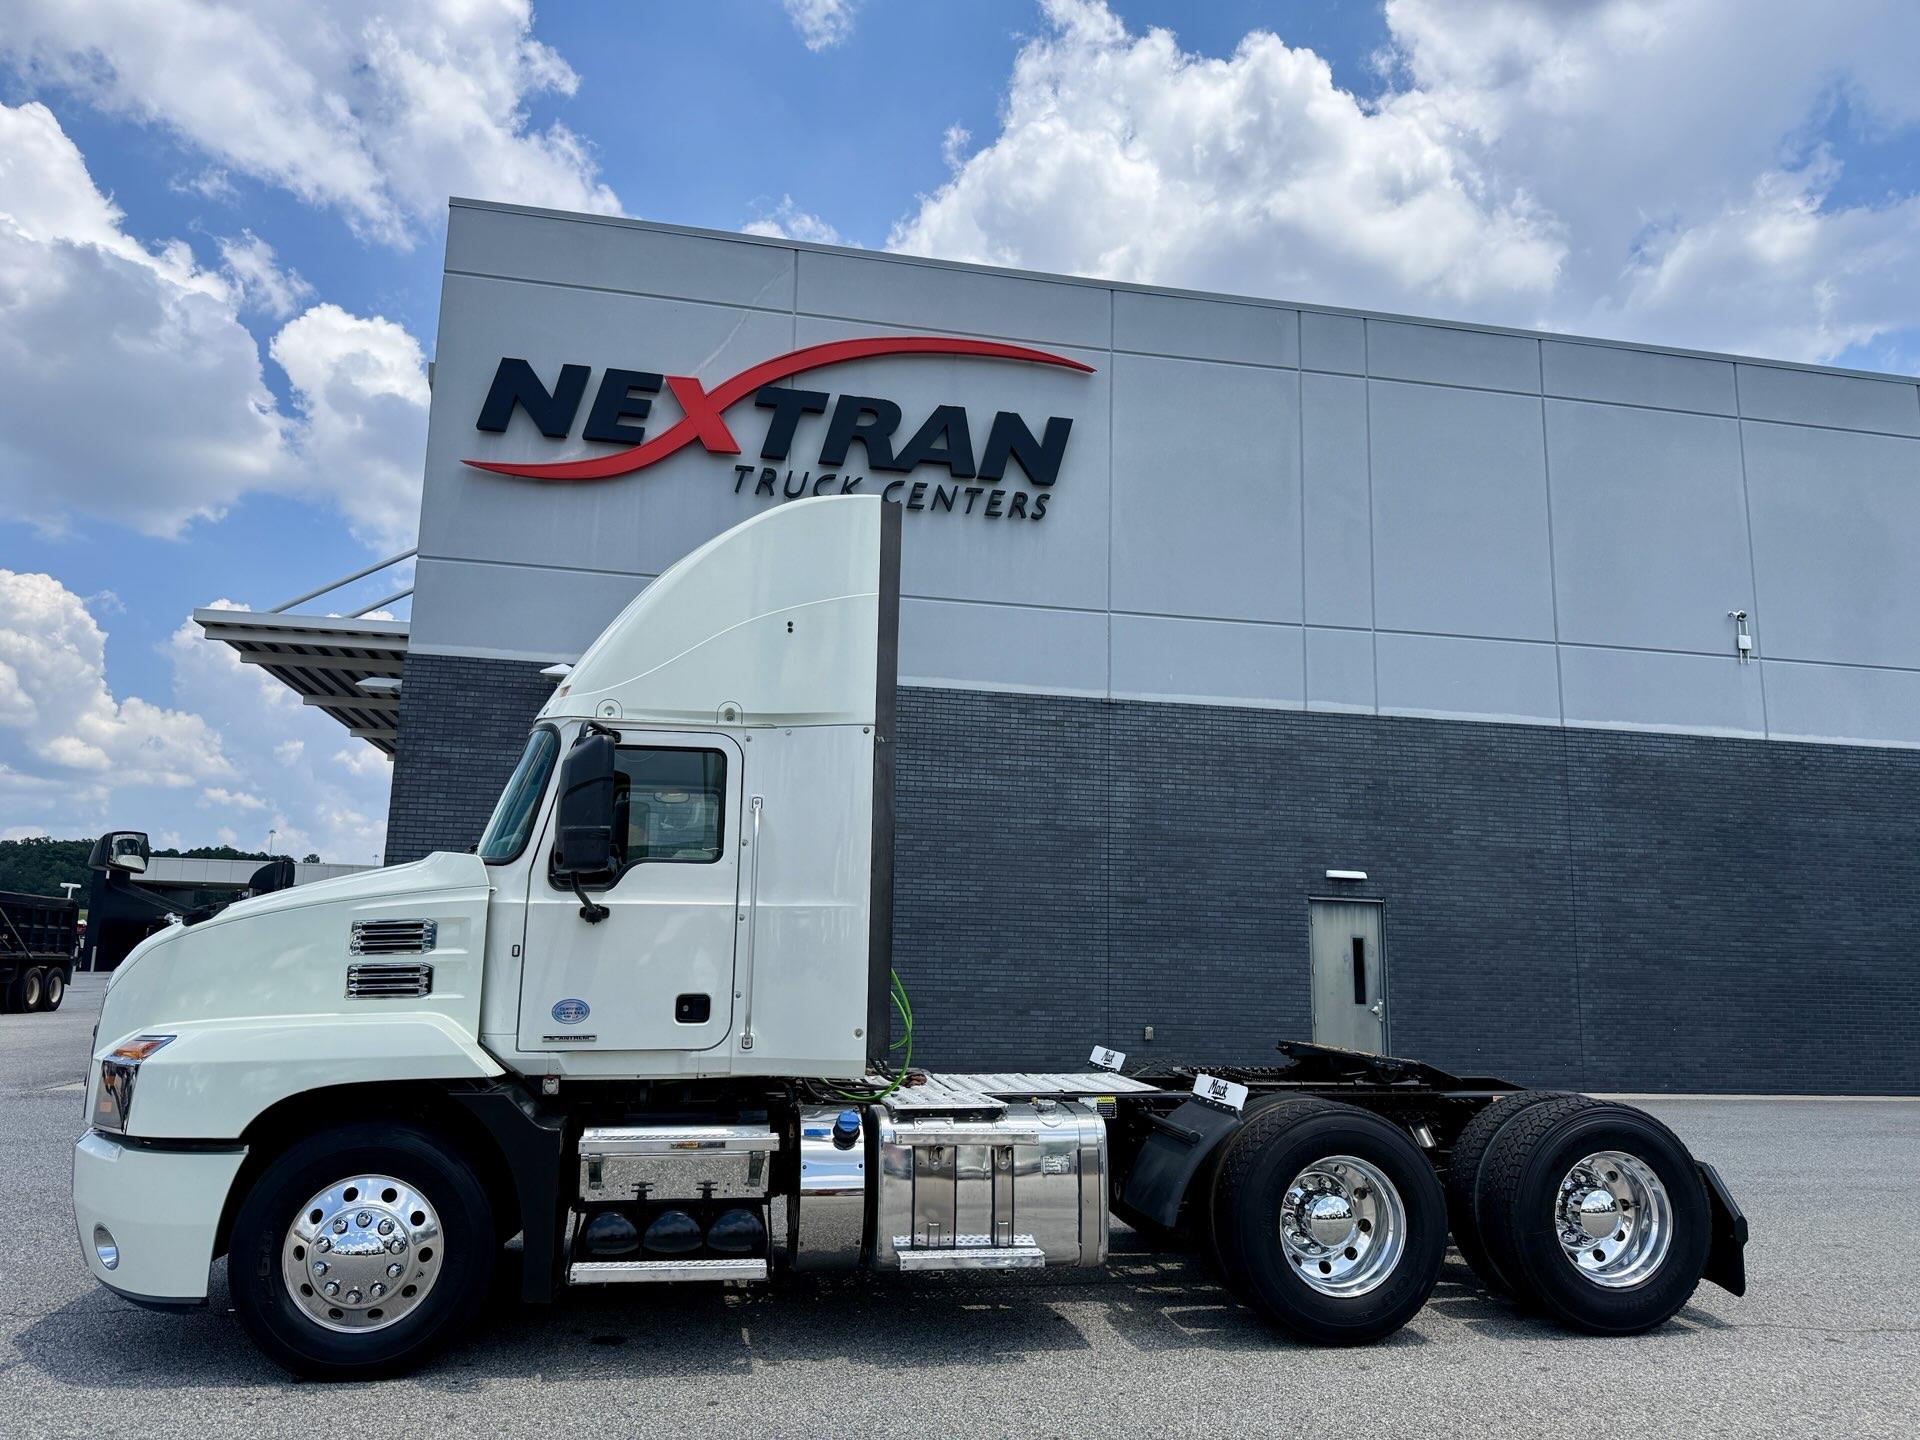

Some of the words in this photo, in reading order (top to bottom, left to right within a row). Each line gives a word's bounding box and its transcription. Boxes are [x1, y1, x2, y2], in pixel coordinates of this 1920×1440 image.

[475, 356, 1074, 487] NEXTRAN
[734, 464, 864, 499] TRUCK
[881, 480, 1051, 521] CENTERS
[1207, 1078, 1230, 1100] Mack
